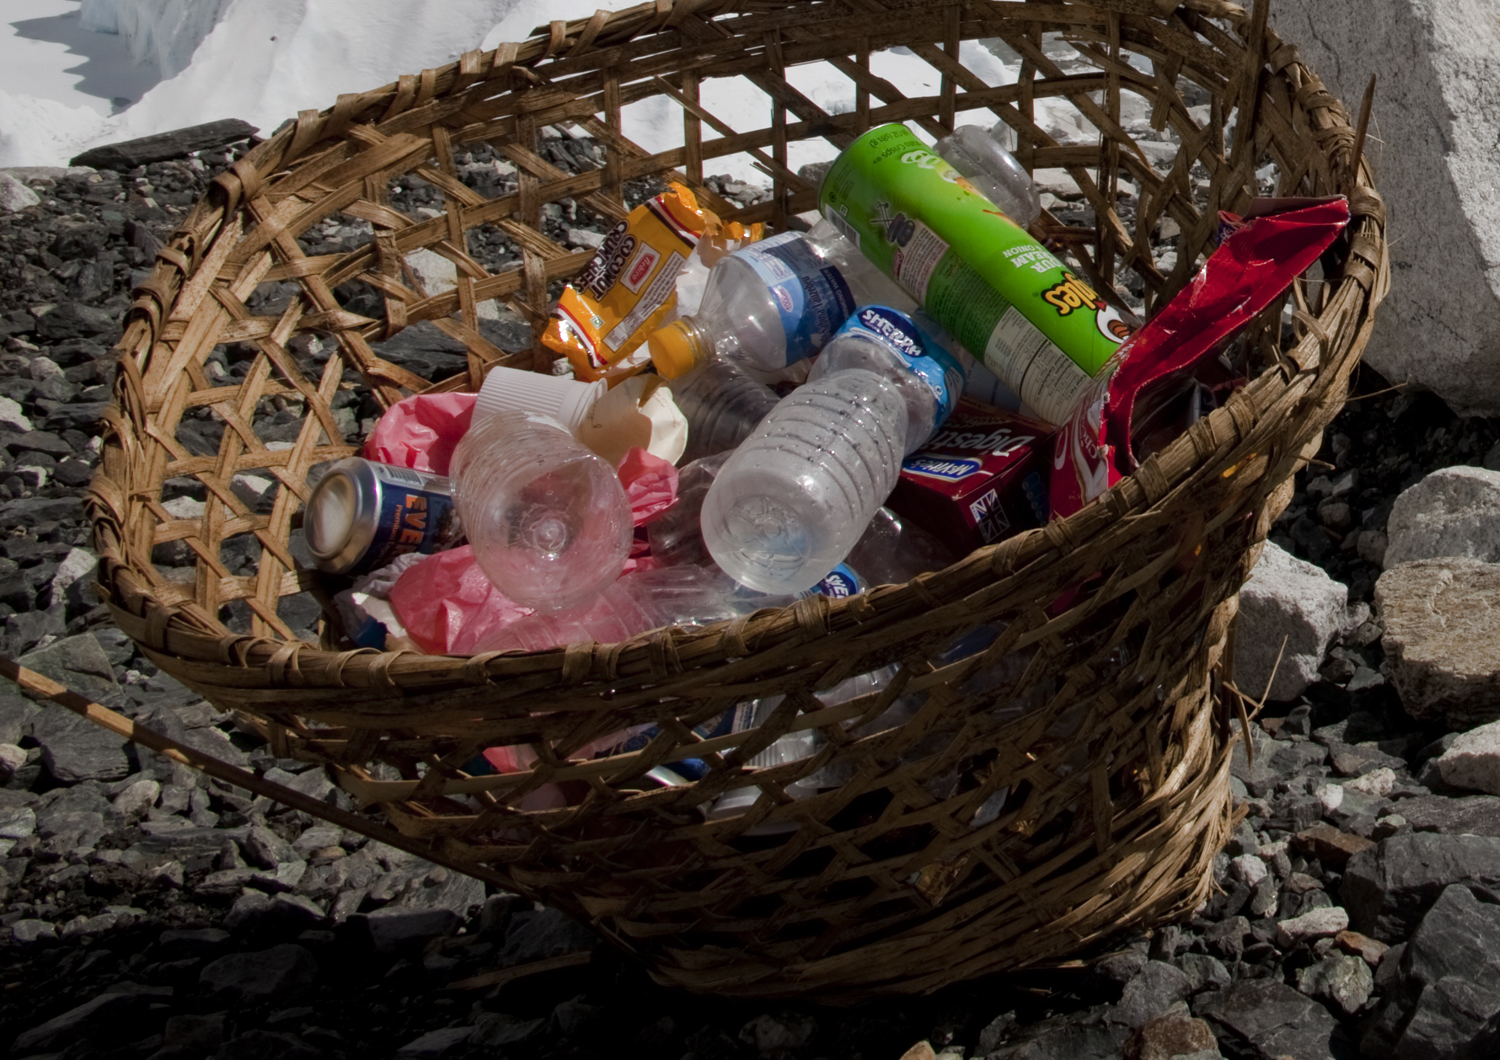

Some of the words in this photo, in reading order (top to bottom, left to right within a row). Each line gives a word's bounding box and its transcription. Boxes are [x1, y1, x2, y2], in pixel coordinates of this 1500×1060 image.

[881, 143, 905, 158] Crisps
[569, 220, 628, 294] CRUNCHEES
[1002, 244, 1034, 258] ONION
[589, 236, 637, 301] COCONUT
[822, 267, 839, 289] WATER
[861, 308, 921, 356] SHERPA
[826, 574, 850, 599] SHE
